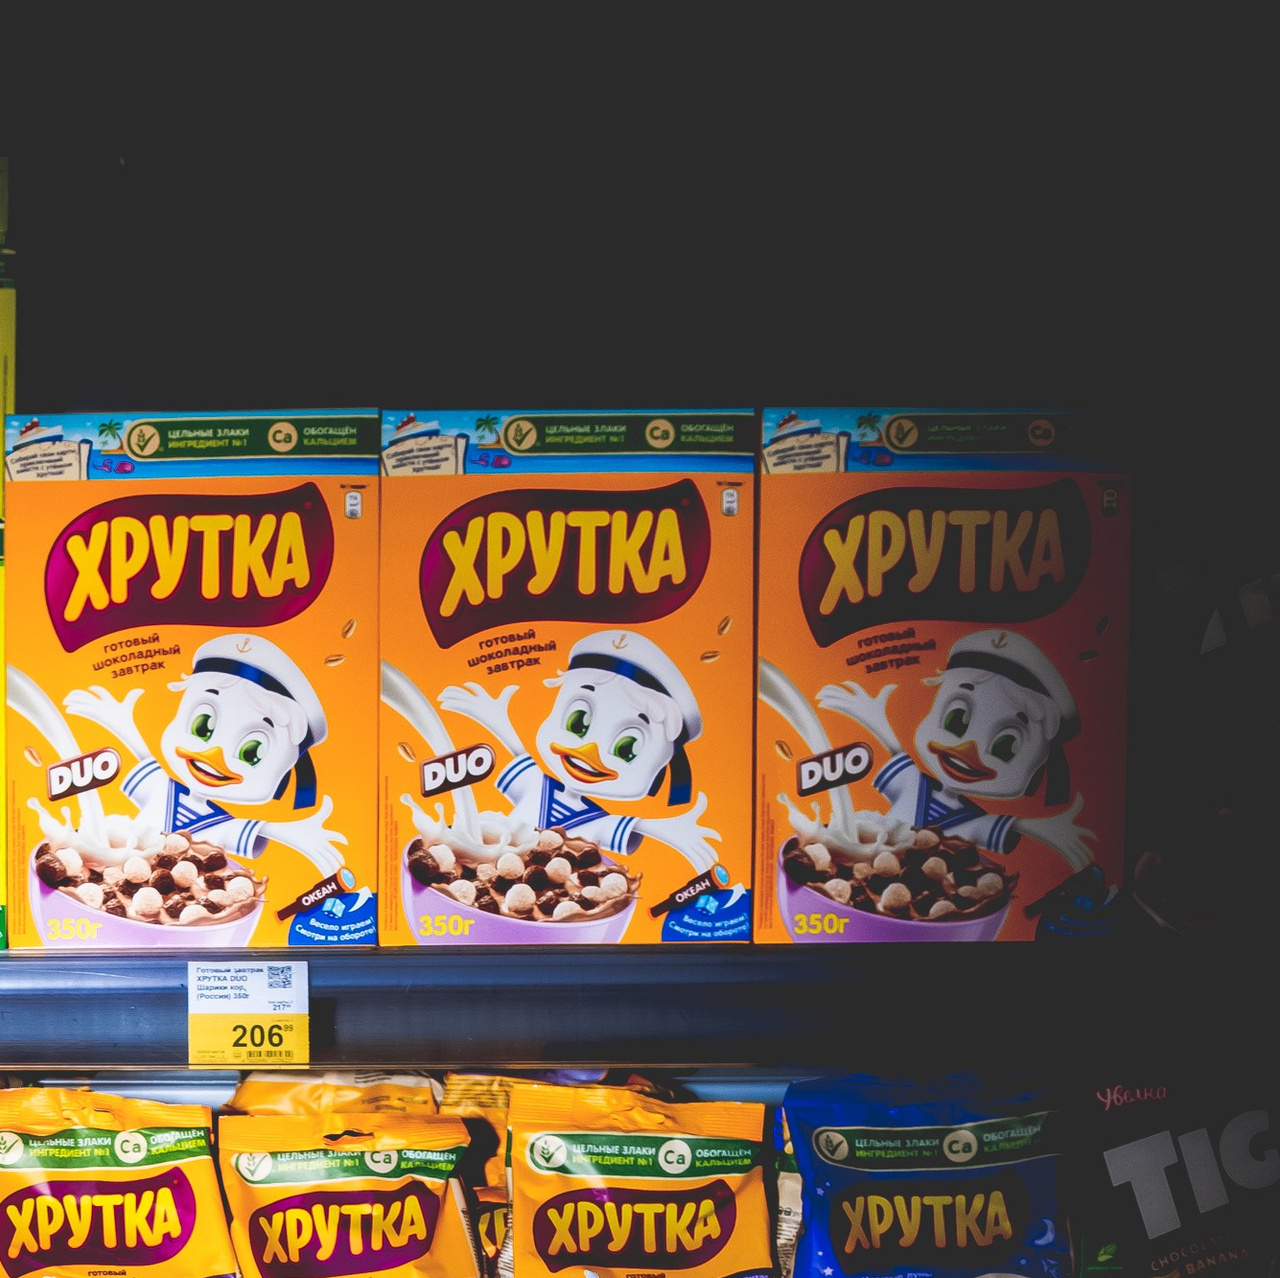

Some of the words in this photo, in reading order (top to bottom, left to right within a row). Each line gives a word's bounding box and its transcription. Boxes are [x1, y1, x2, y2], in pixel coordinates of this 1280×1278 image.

[168, 429, 214, 439] ЦЕЛЬНЫЕ
[217, 428, 249, 437] ЗЛАКИ
[63, 511, 311, 622] ХРУТКА
[439, 508, 687, 617] ХРУТКА
[819, 508, 1066, 616] ХРУТКА
[104, 632, 160, 653] готовый
[478, 628, 536, 650] готовый
[92, 643, 181, 672] шоколадный
[467, 640, 557, 668] шоколадный
[486, 656, 541, 675] завтрак
[111, 660, 166, 679] завтрак
[49, 754, 118, 798] DUO
[423, 748, 493, 792] DUO
[800, 746, 870, 791] DUO
[301, 882, 337, 907] ОКЕАН
[675, 878, 711, 904] ОКЕАН
[46, 918, 103, 940] 350г
[295, 923, 326, 940] Смотри
[419, 915, 475, 936] 350г
[793, 913, 850, 934] 350г
[232, 1024, 283, 1048] 206
[283, 1024, 294, 1033] 99
[29, 1138, 75, 1147] ЦЕЛЬНЫЕ
[78, 1137, 111, 1146] ЗЛАКИ
[572, 1144, 620, 1154] ЦЕЛЬНЫЕ
[623, 1146, 656, 1156] ЗЛАКИ
[6, 1187, 183, 1259] ХРУТКА
[259, 1195, 427, 1264] ХРУТКА
[547, 1199, 721, 1255] ХРУТКА
[841, 1190, 1012, 1255] ХРУТКА
[87, 1269, 126, 1277] готовый
[1185, 1248, 1250, 1275] BANANA
